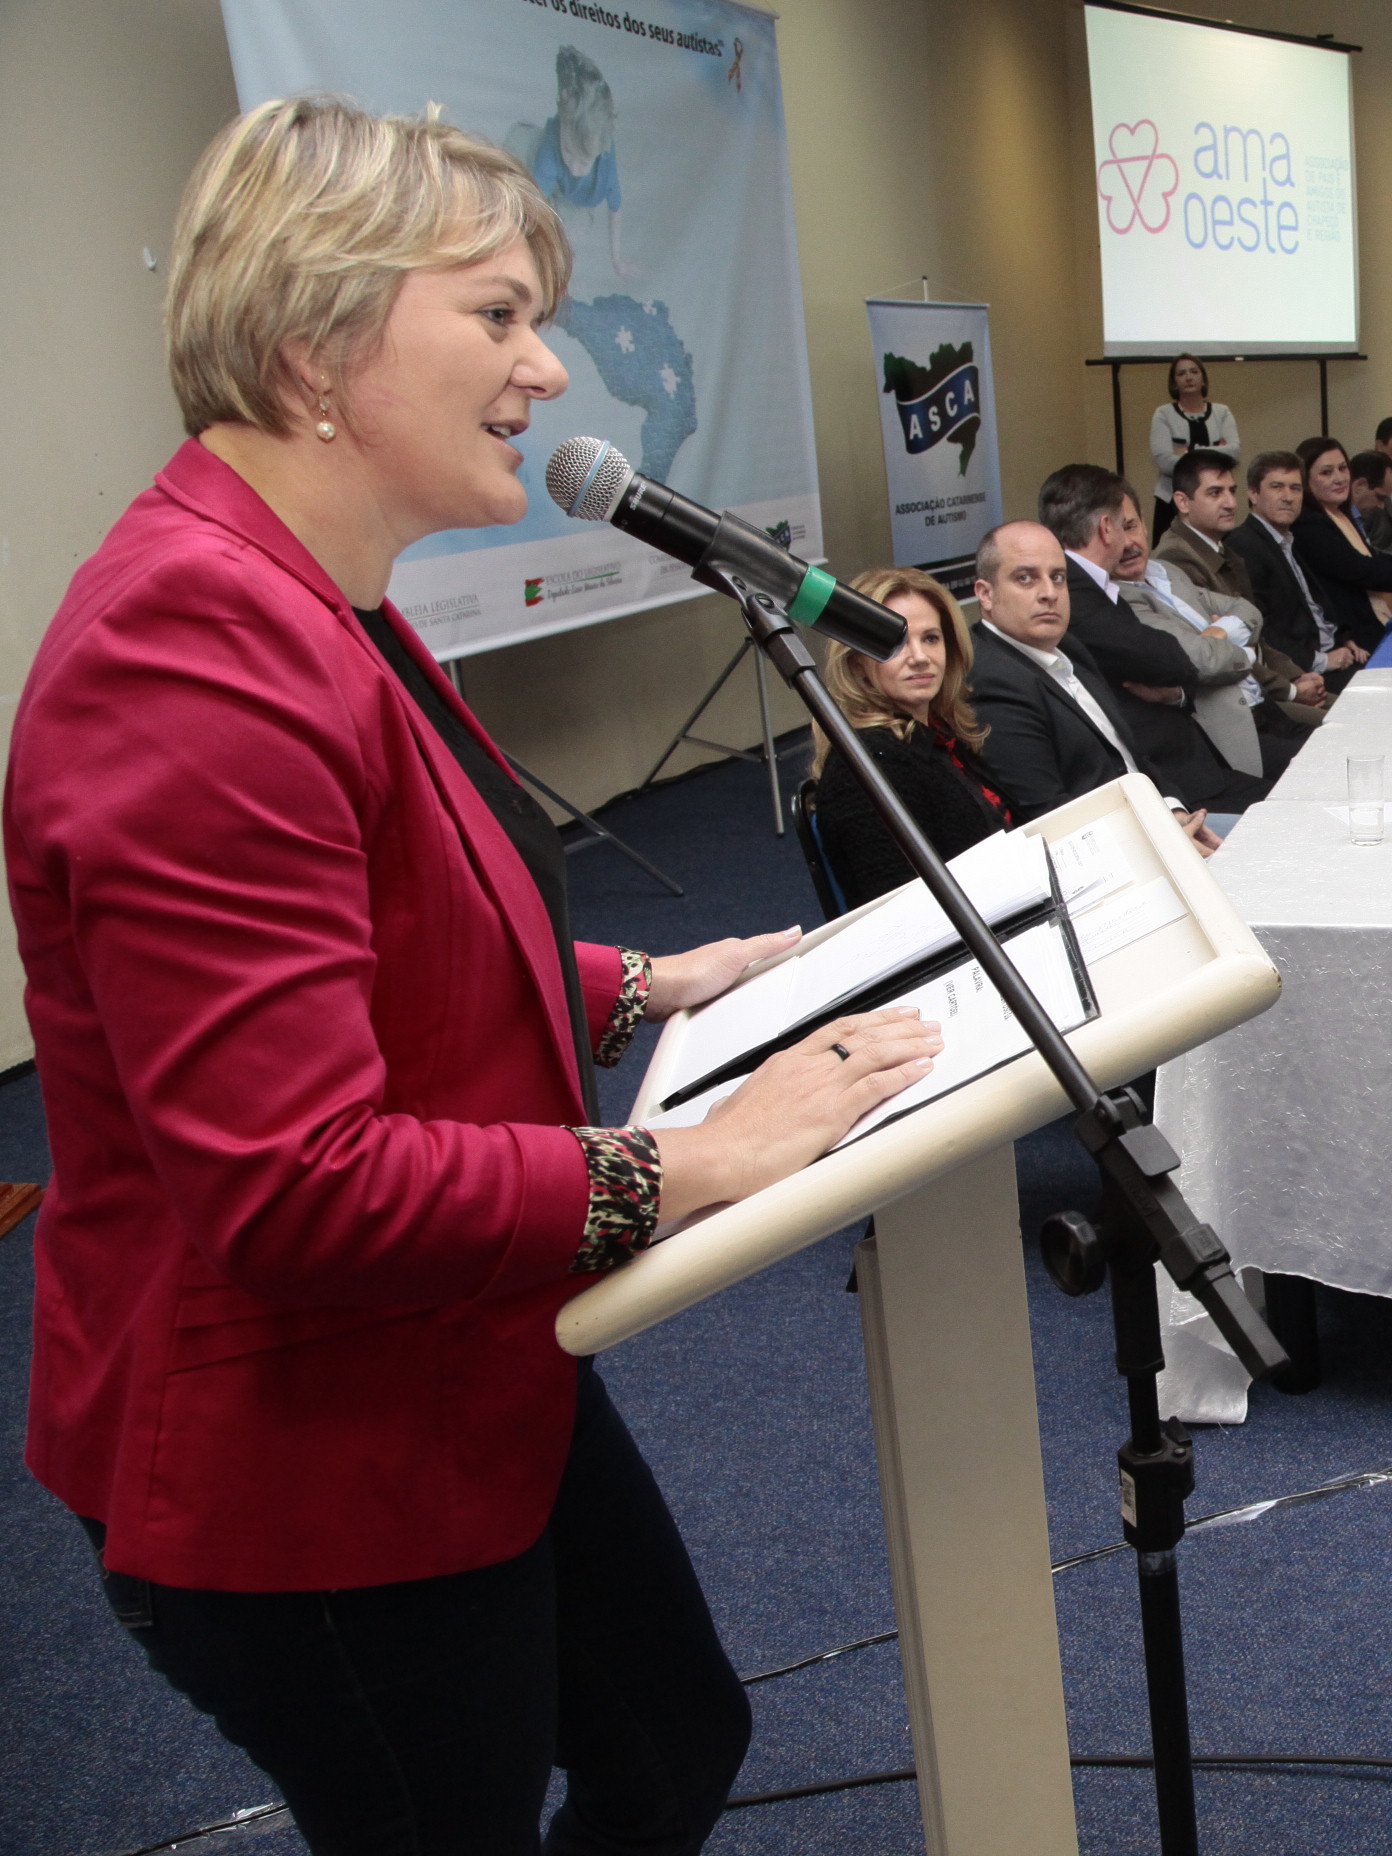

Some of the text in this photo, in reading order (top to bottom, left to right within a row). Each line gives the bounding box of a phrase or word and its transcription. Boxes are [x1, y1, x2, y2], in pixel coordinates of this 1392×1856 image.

[569, 0, 621, 30] direitos
[623, 12, 646, 37] dos
[649, 24, 675, 45] seus
[1194, 121, 1295, 188] ama
[1183, 177, 1300, 255] oeste
[909, 380, 975, 440] ASCA
[895, 496, 945, 516] ASSOCIAÇÃO
[925, 509, 967, 527] DE AUTISMO
[431, 593, 479, 613] LEGISLATIVA
